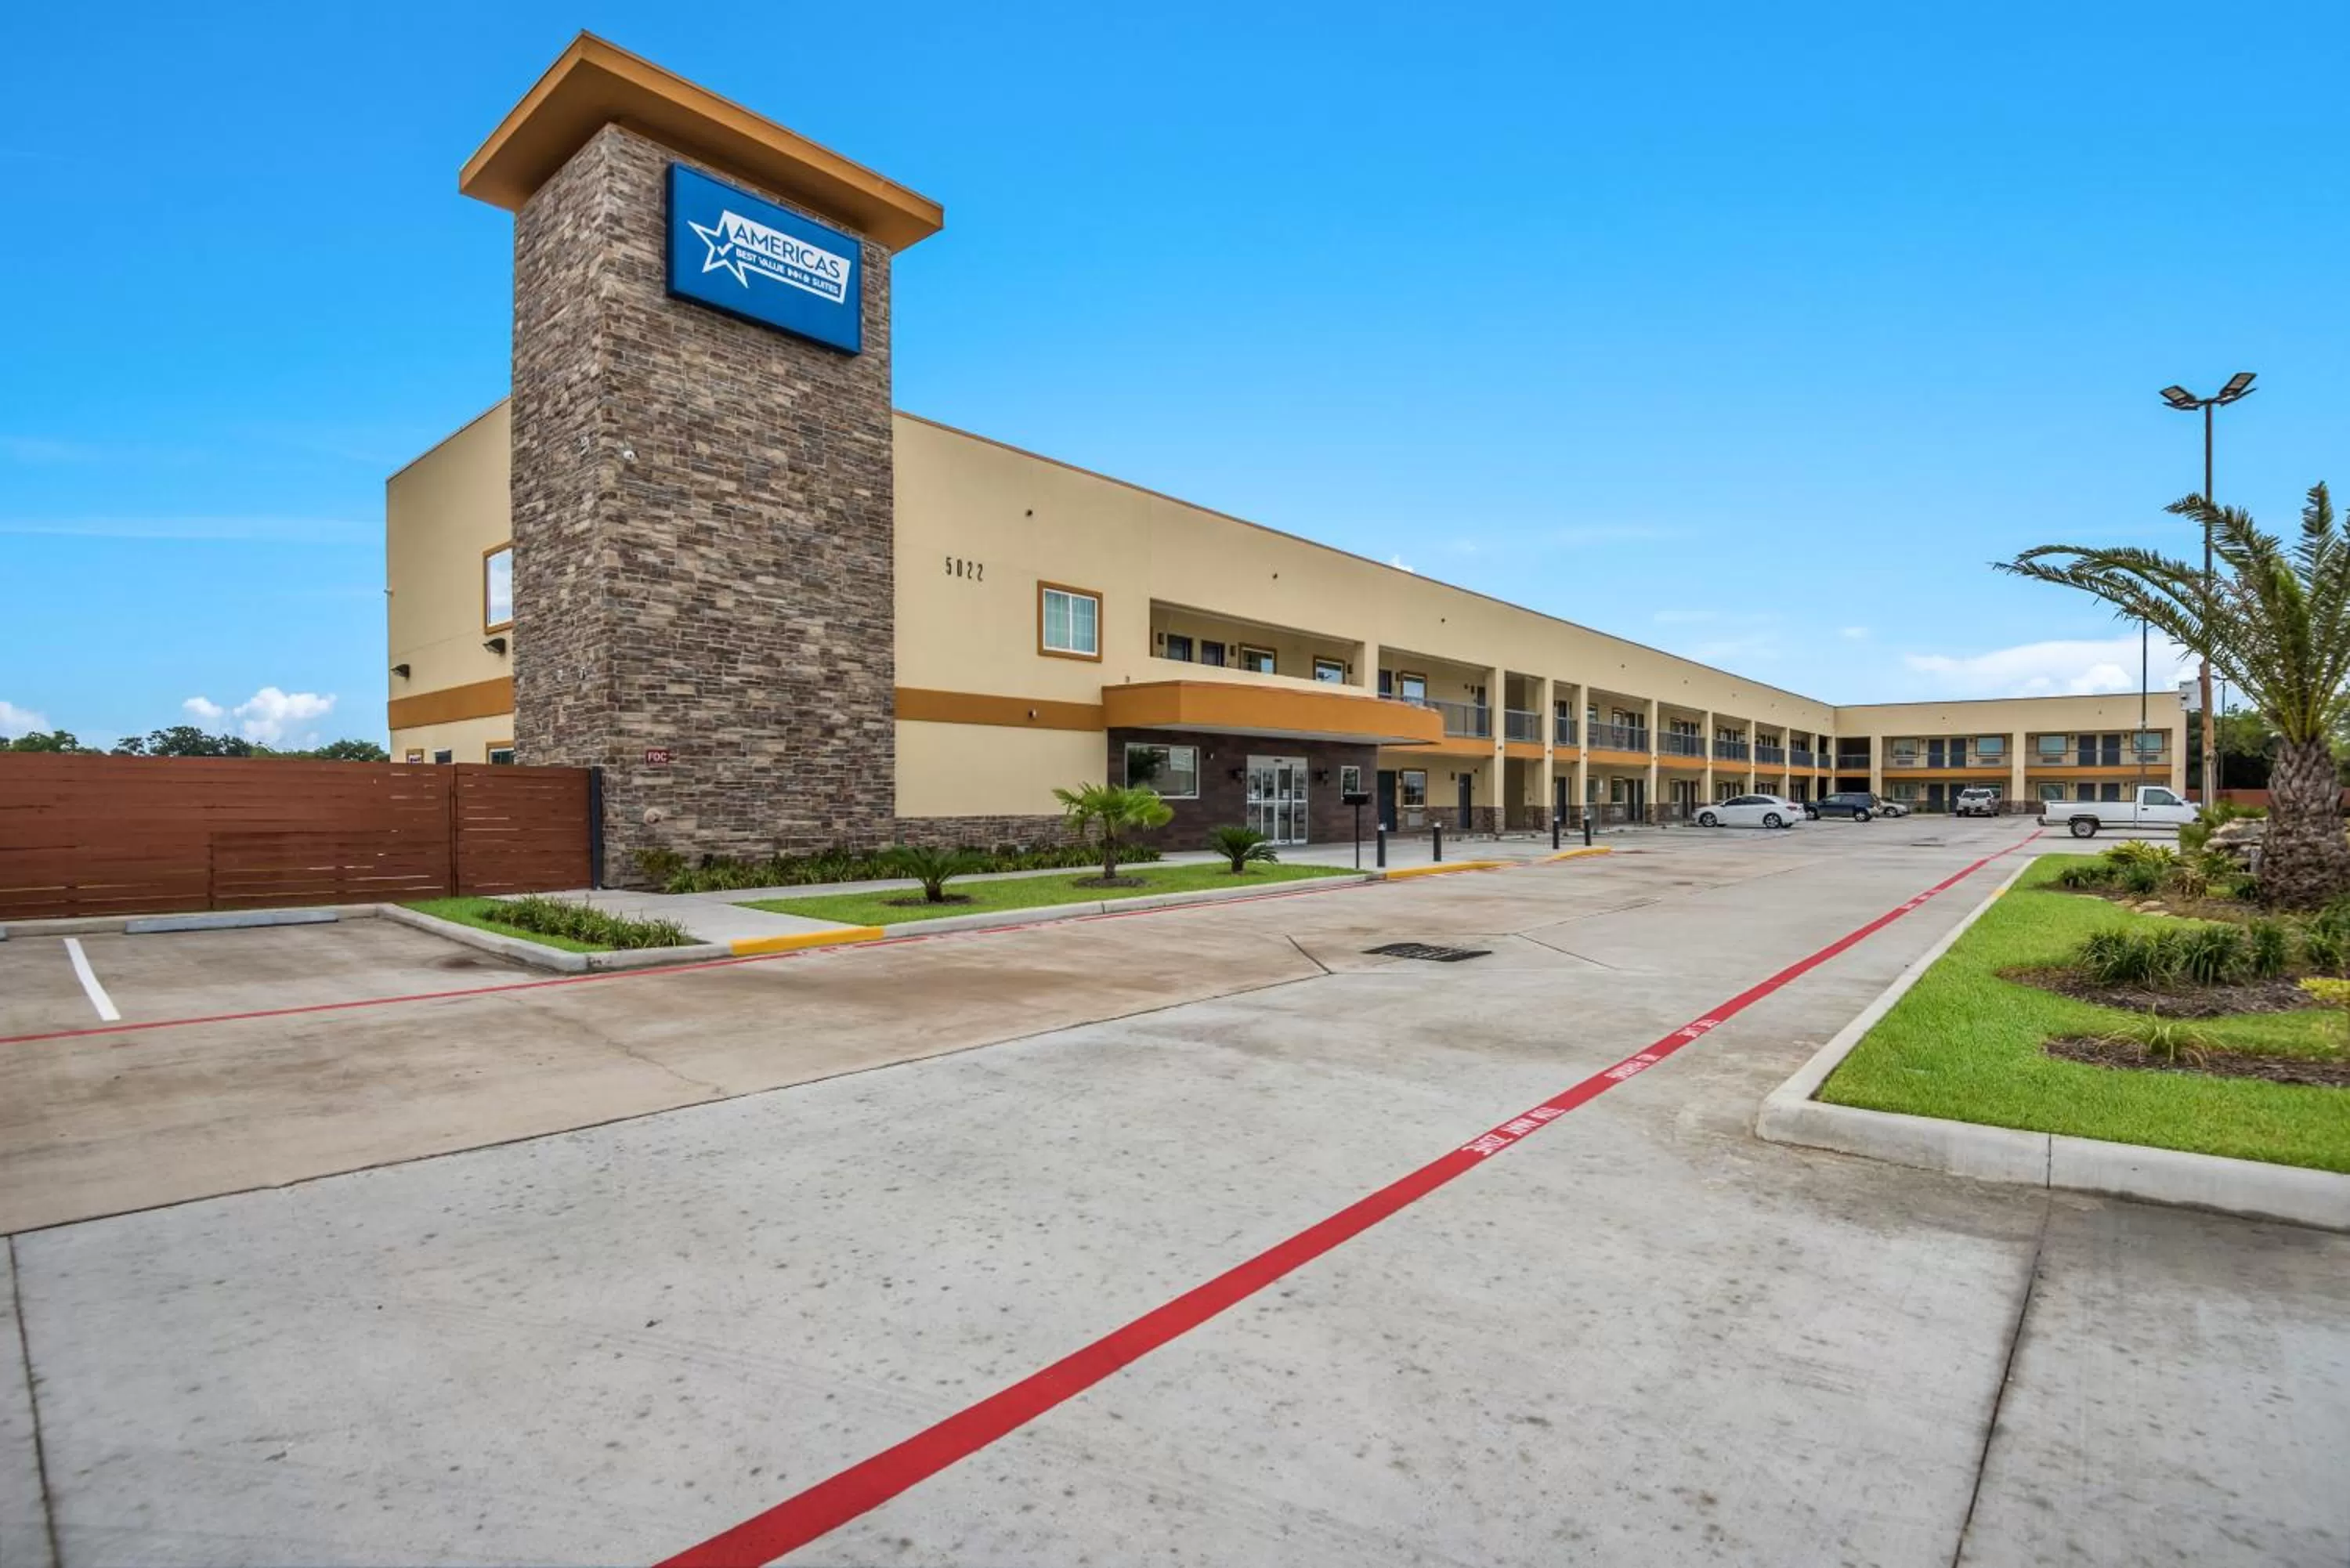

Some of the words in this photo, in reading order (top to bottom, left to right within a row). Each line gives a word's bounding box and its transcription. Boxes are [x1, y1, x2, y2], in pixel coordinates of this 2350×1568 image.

[733, 224, 841, 279] AMERICAS
[736, 248, 757, 263] BEST
[758, 257, 786, 274] VALUE
[945, 556, 983, 582] 5022
